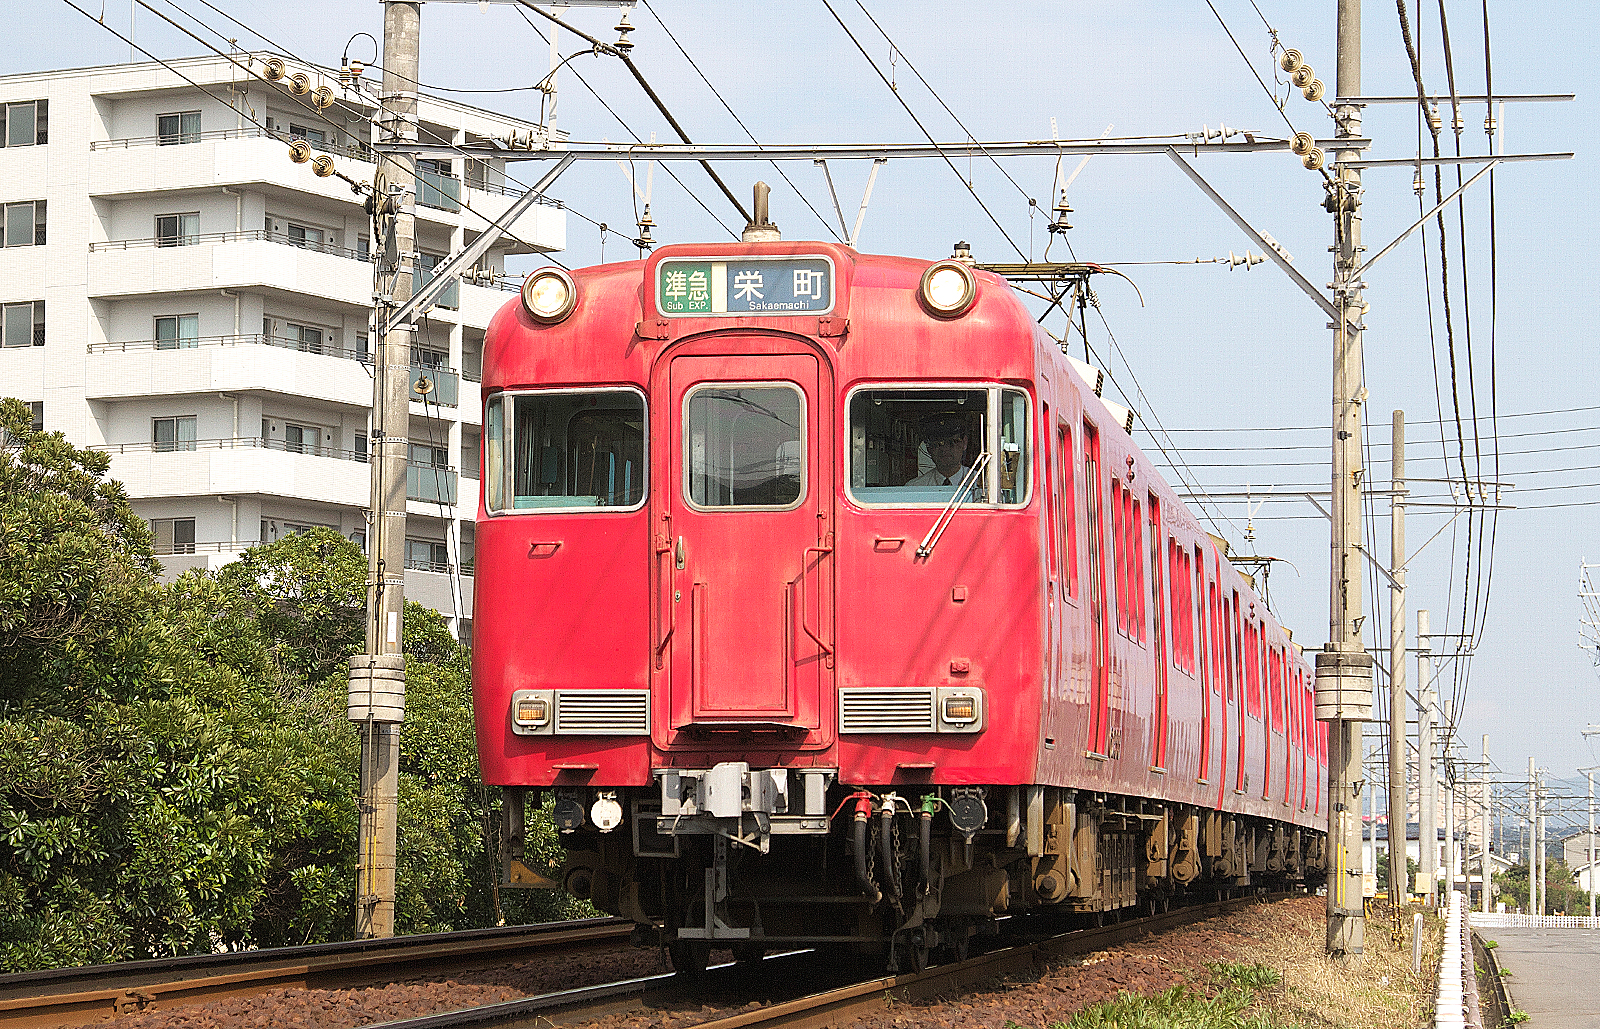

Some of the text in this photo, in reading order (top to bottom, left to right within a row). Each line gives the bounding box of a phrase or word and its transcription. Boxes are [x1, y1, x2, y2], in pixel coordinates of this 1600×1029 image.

[665, 271, 709, 301] 準急
[733, 270, 824, 301] 栄町
[667, 301, 708, 310] Sub EXP.
[749, 301, 809, 310] Sakaemachi
